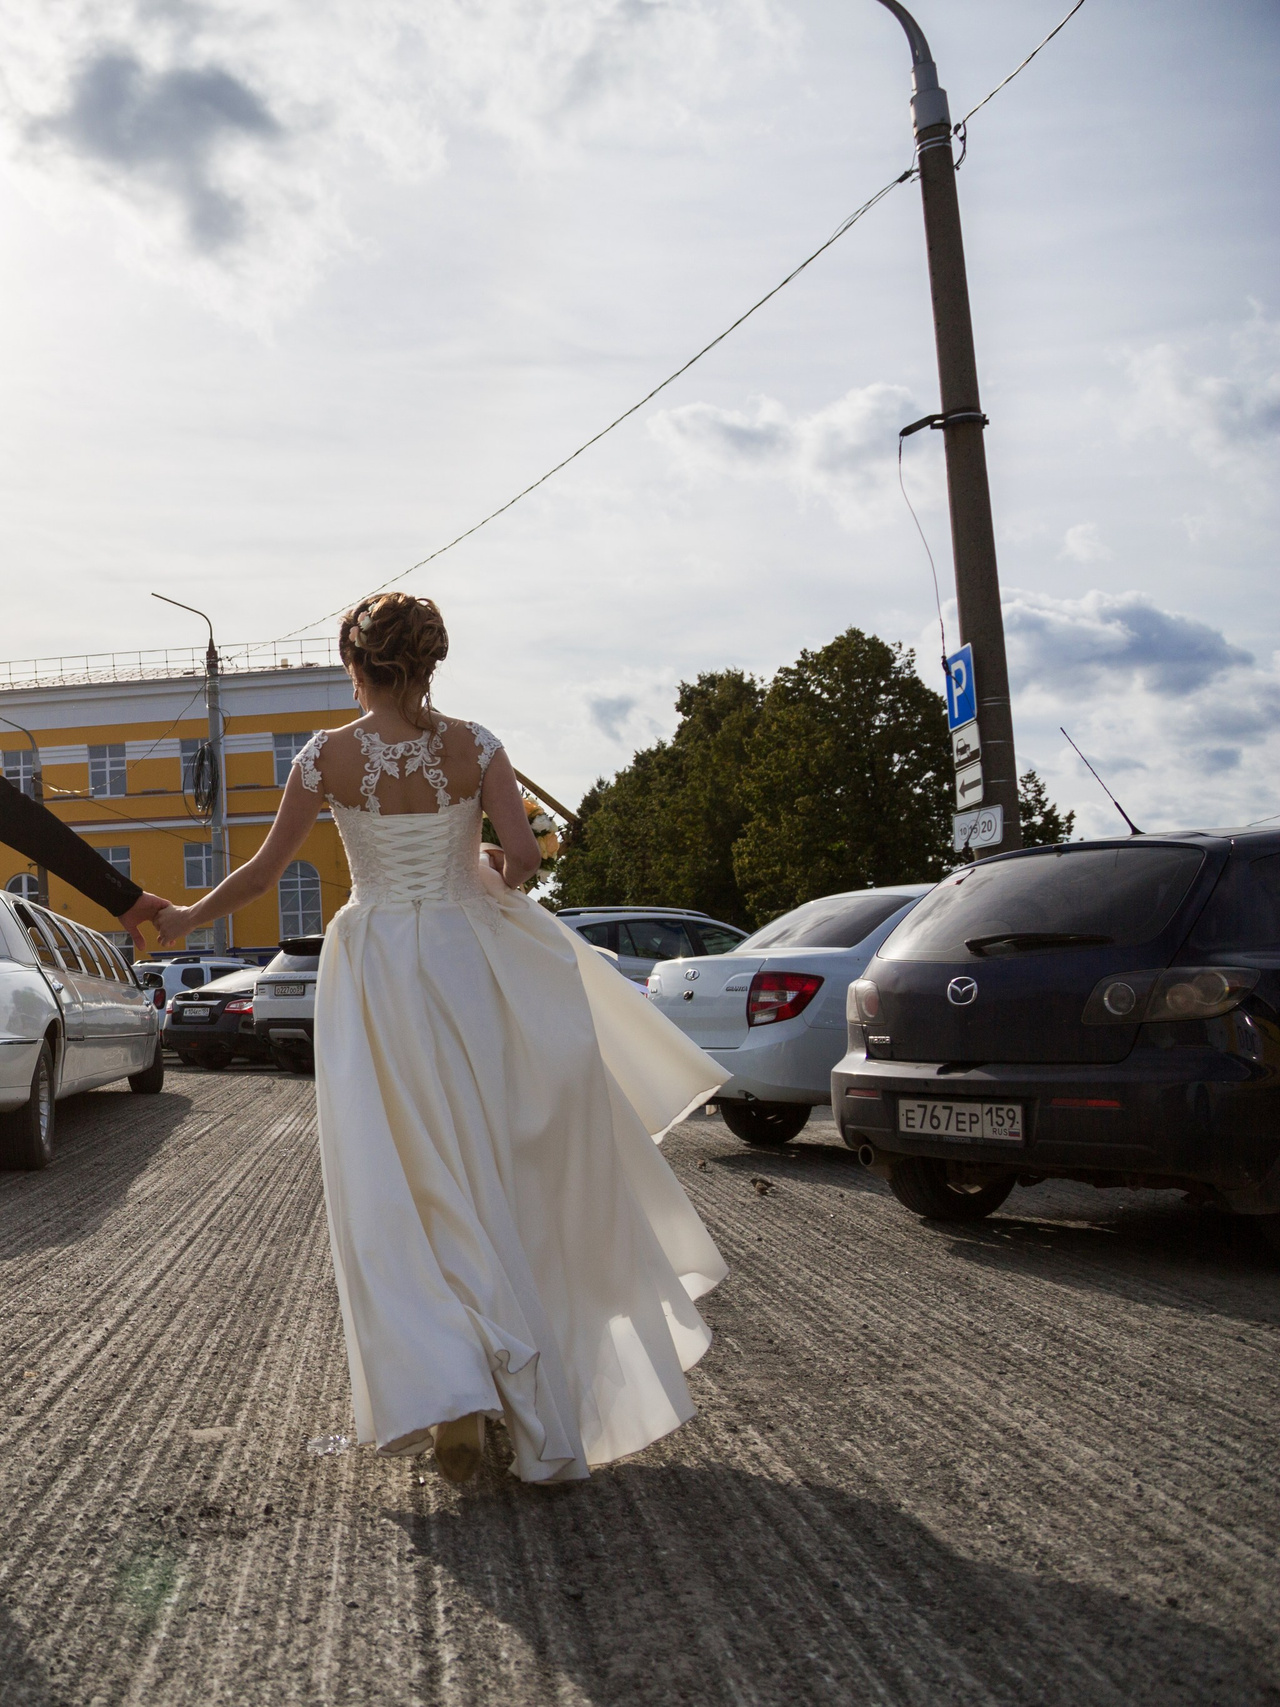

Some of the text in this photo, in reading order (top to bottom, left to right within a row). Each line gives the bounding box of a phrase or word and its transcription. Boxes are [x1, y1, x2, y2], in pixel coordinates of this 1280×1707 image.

[951, 659, 966, 719] P
[981, 820, 992, 833] 20
[985, 1106, 1017, 1128] 159
[992, 1127, 1008, 1136] RUS
